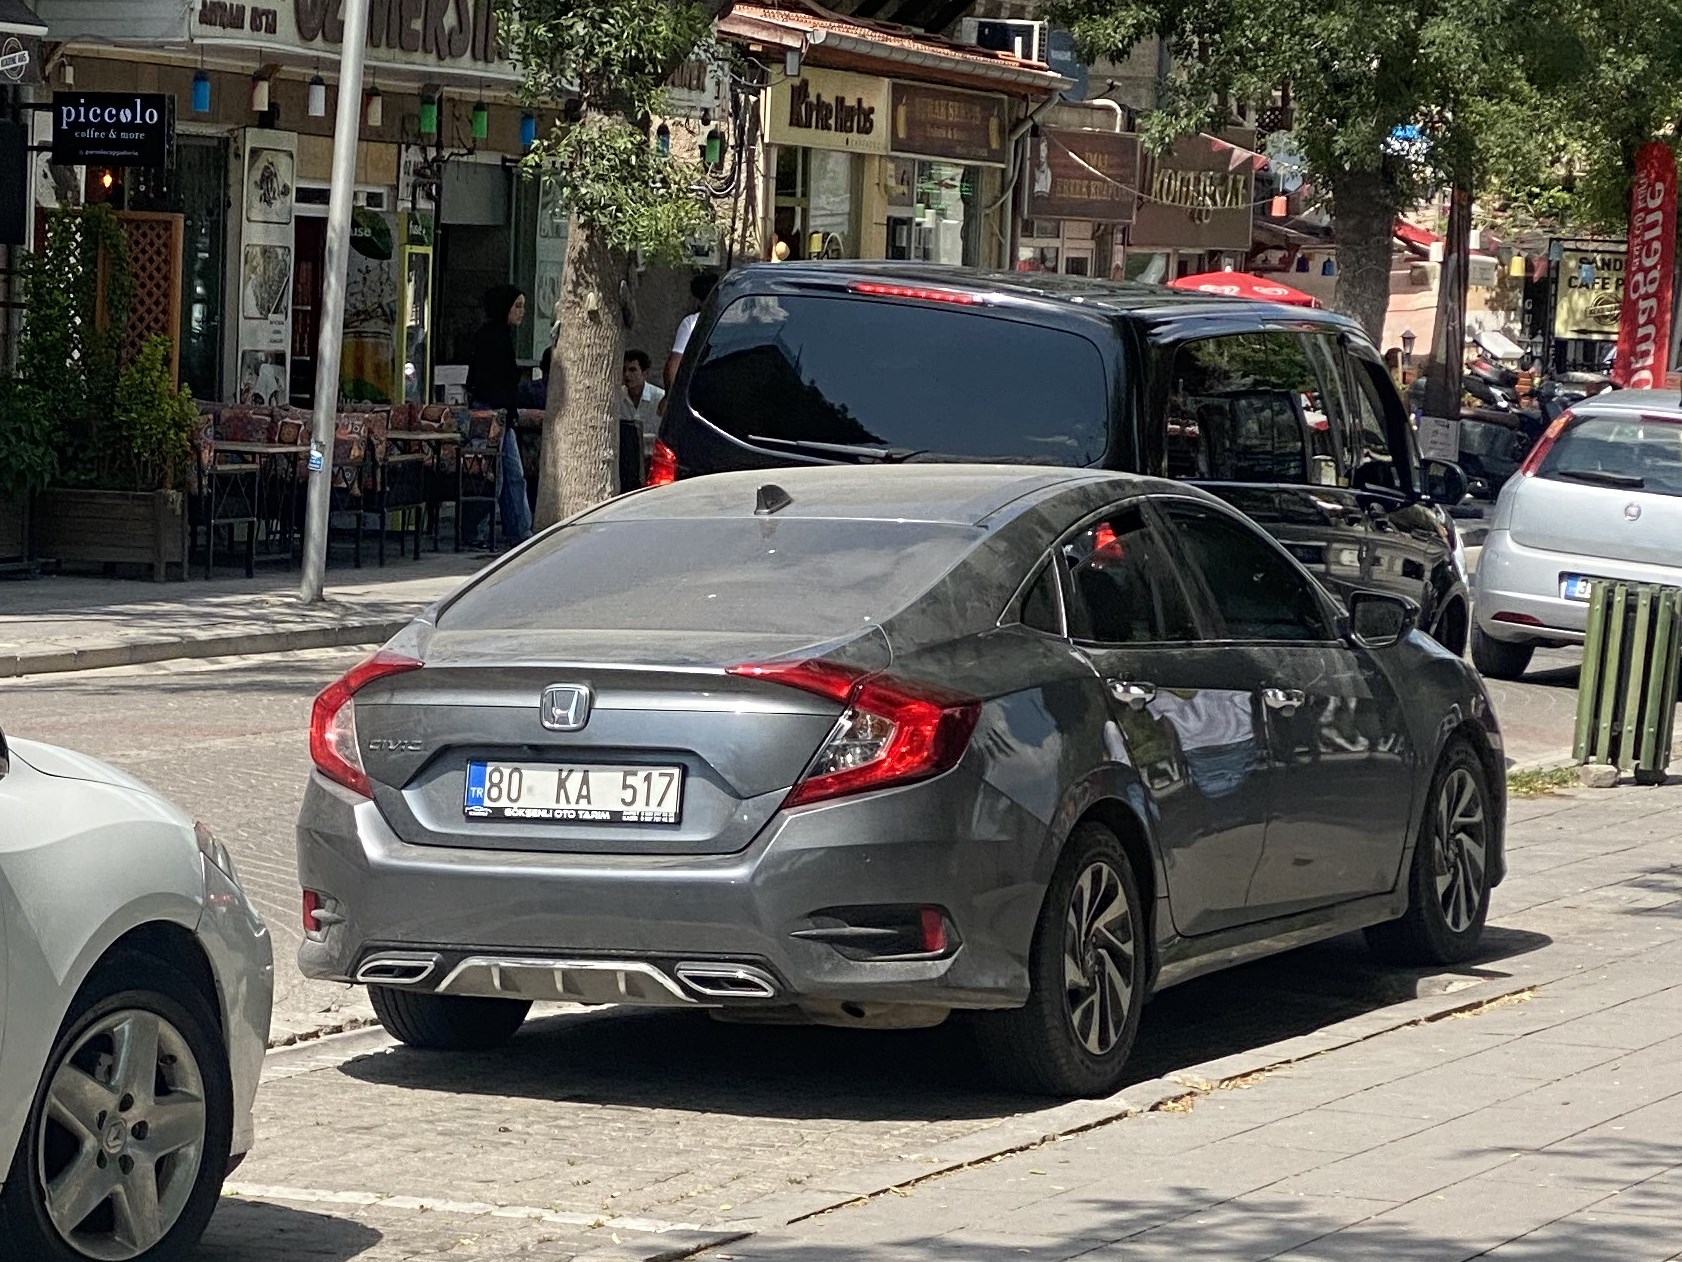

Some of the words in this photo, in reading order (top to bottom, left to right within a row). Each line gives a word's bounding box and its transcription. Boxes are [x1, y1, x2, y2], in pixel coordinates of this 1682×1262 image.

[61, 98, 158, 130] piccolo
[75, 128, 106, 138] coffee
[109, 129, 117, 138] &
[369, 739, 423, 751] CIVIC
[470, 786, 484, 799] TR
[487, 766, 523, 803] 80
[555, 768, 592, 805] KA
[621, 770, 675, 808] 517
[554, 809, 576, 819] OTO
